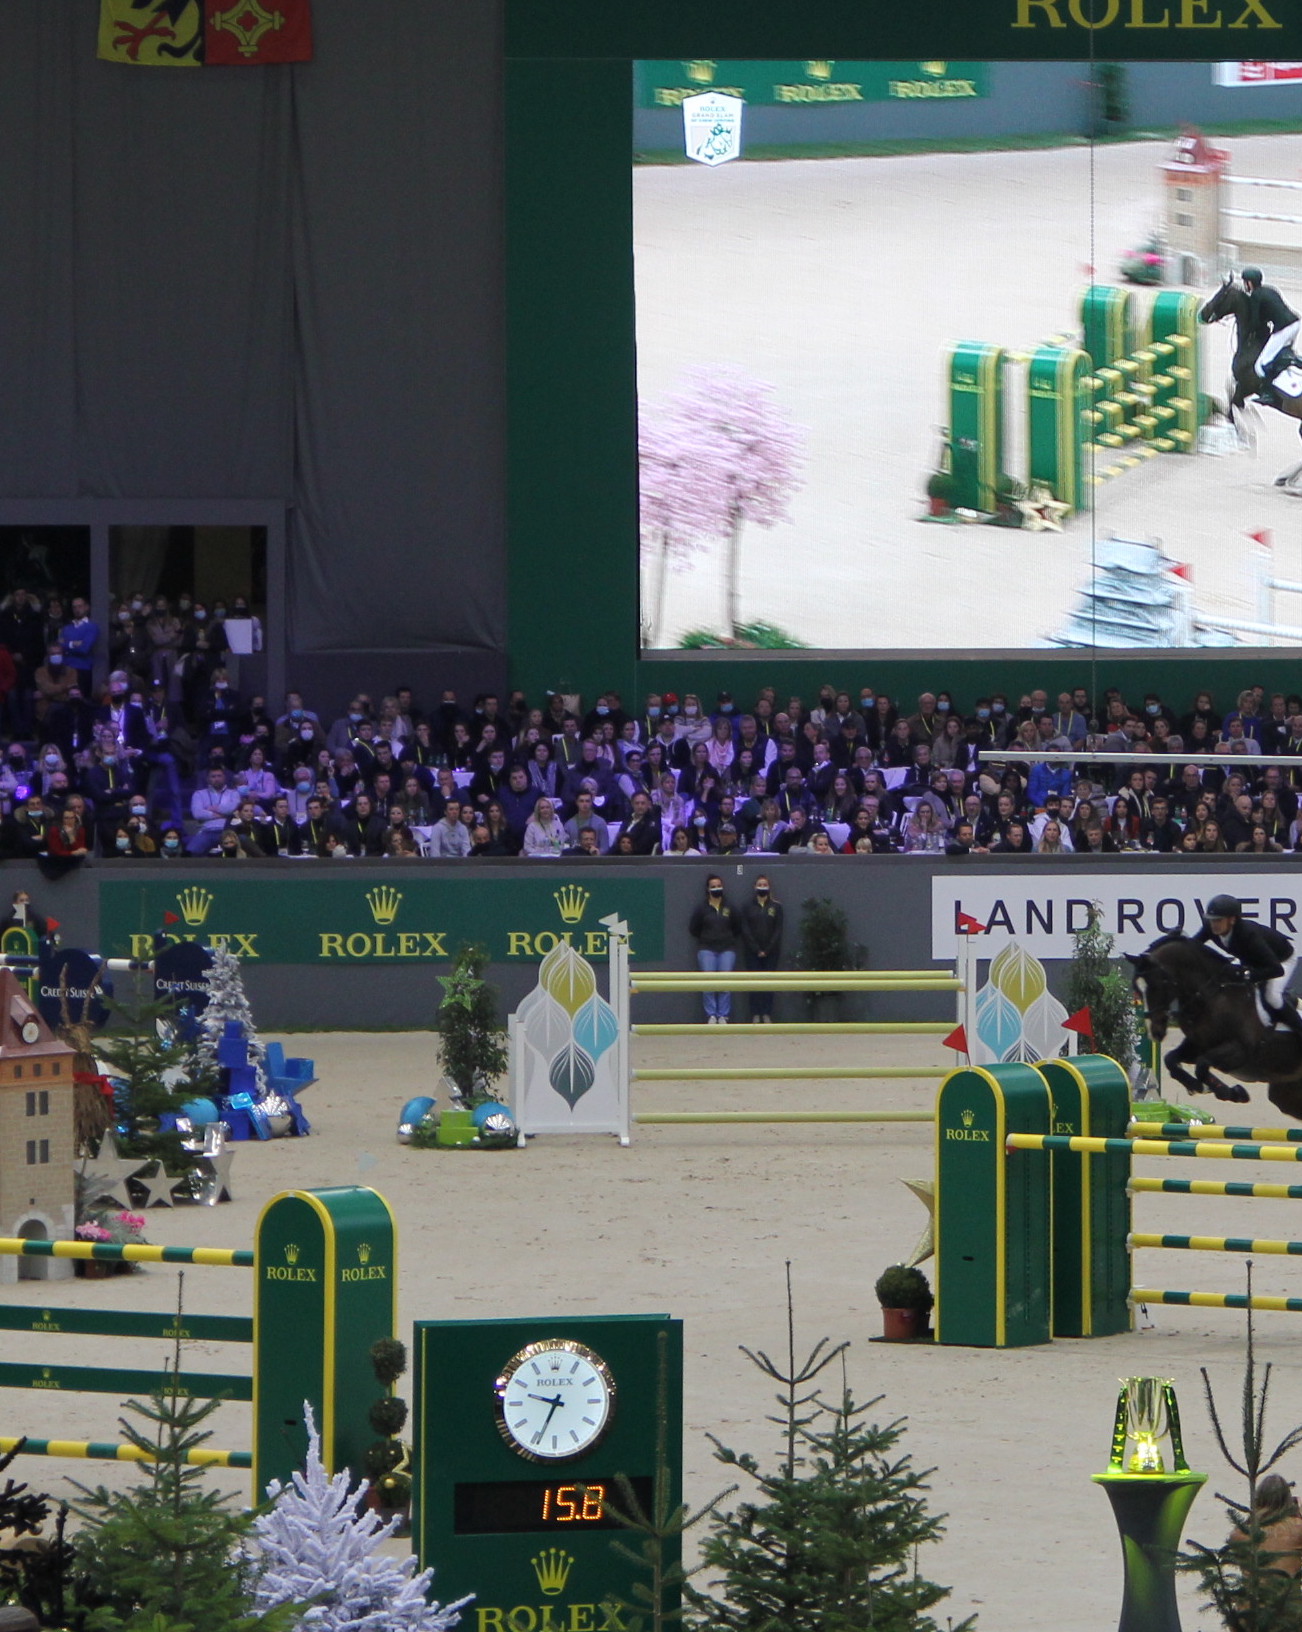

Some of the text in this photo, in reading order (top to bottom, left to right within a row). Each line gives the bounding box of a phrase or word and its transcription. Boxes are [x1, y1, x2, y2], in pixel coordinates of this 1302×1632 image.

[1011, 0, 1283, 29] ROLEX
[319, 932, 448, 957] ROLEX
[946, 1129, 990, 1142] ROLEX
[266, 1266, 317, 1282] ROLEX
[341, 1266, 386, 1282] ROLEX
[536, 1378, 574, 1387] ROLEX
[542, 1484, 604, 1521] 15.8
